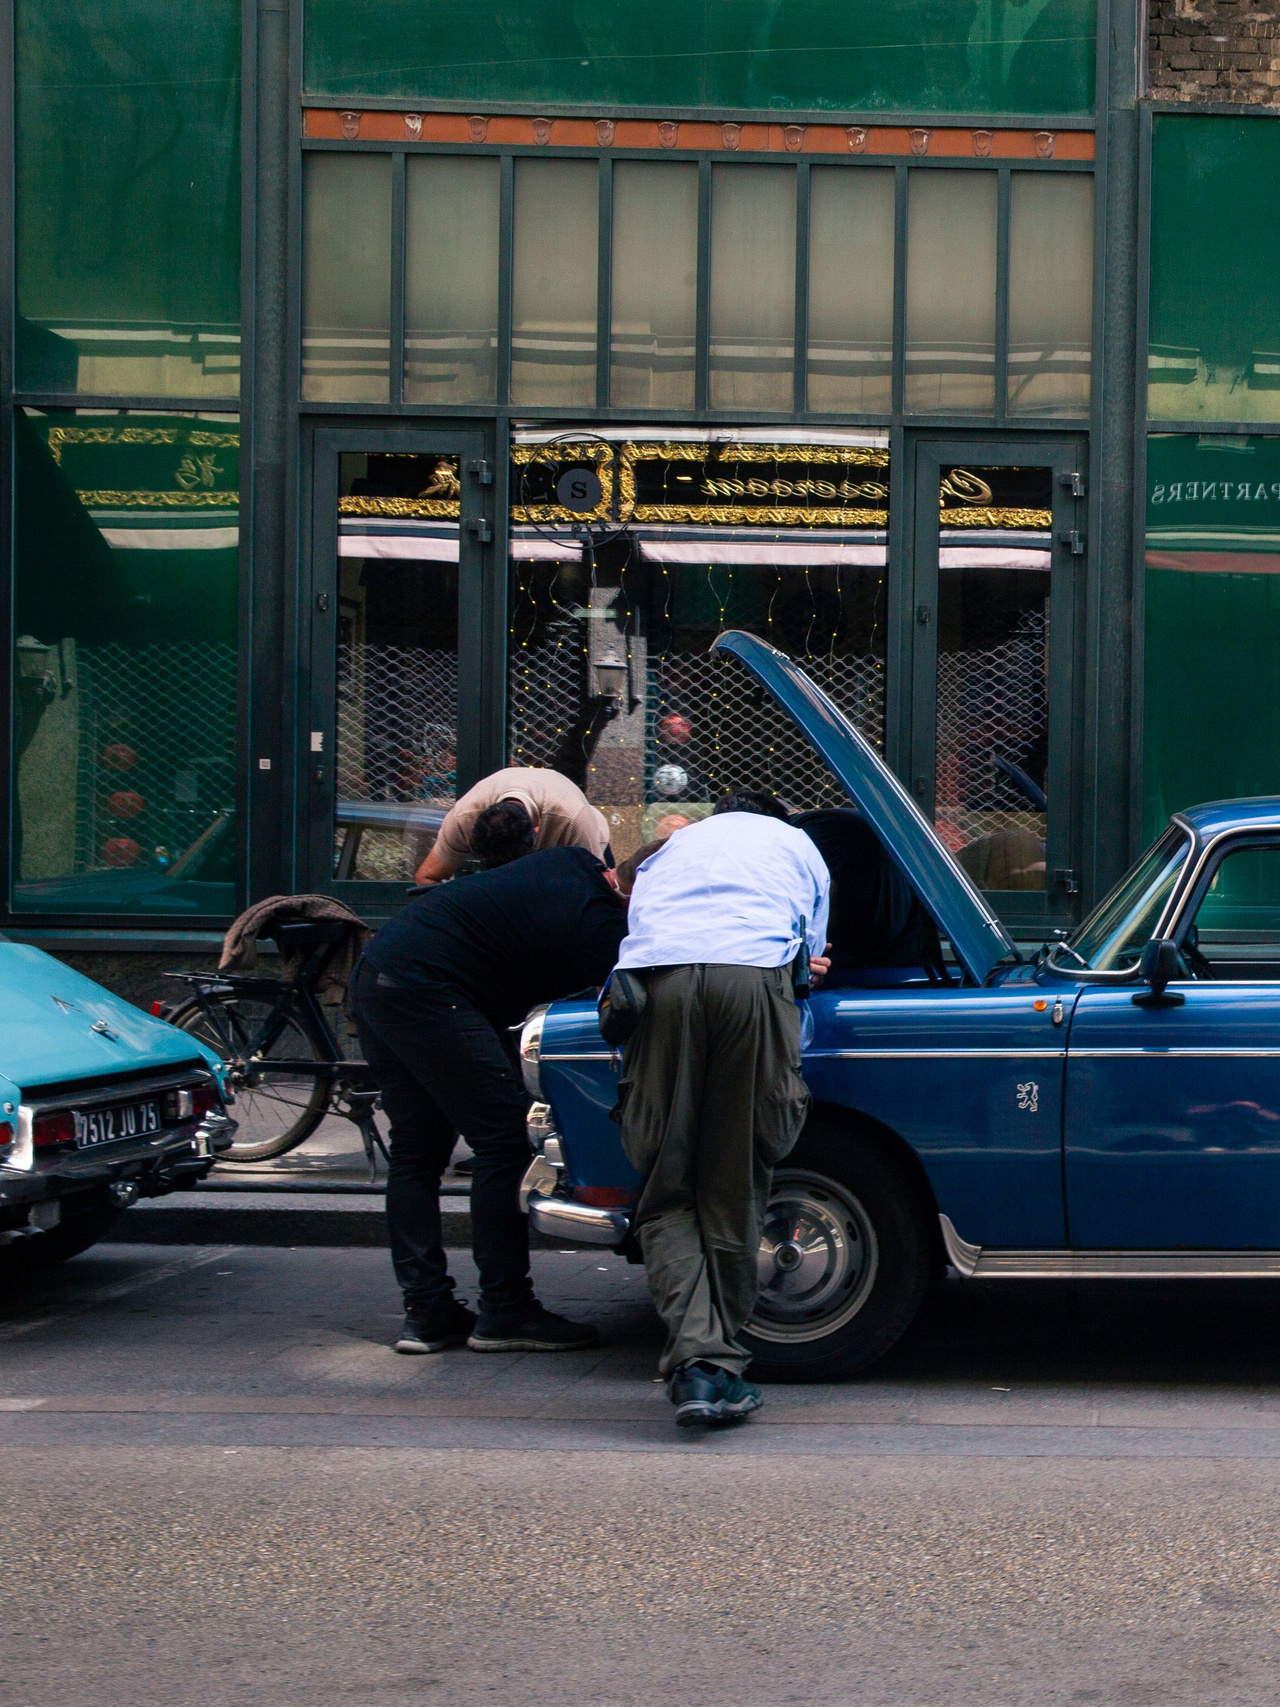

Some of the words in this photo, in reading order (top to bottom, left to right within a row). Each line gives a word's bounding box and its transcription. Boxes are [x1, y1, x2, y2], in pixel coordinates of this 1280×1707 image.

[570, 481, 587, 500] S
[80, 1110, 116, 1146] 7512
[120, 1106, 136, 1137] JU
[139, 1102, 157, 1132] 75
